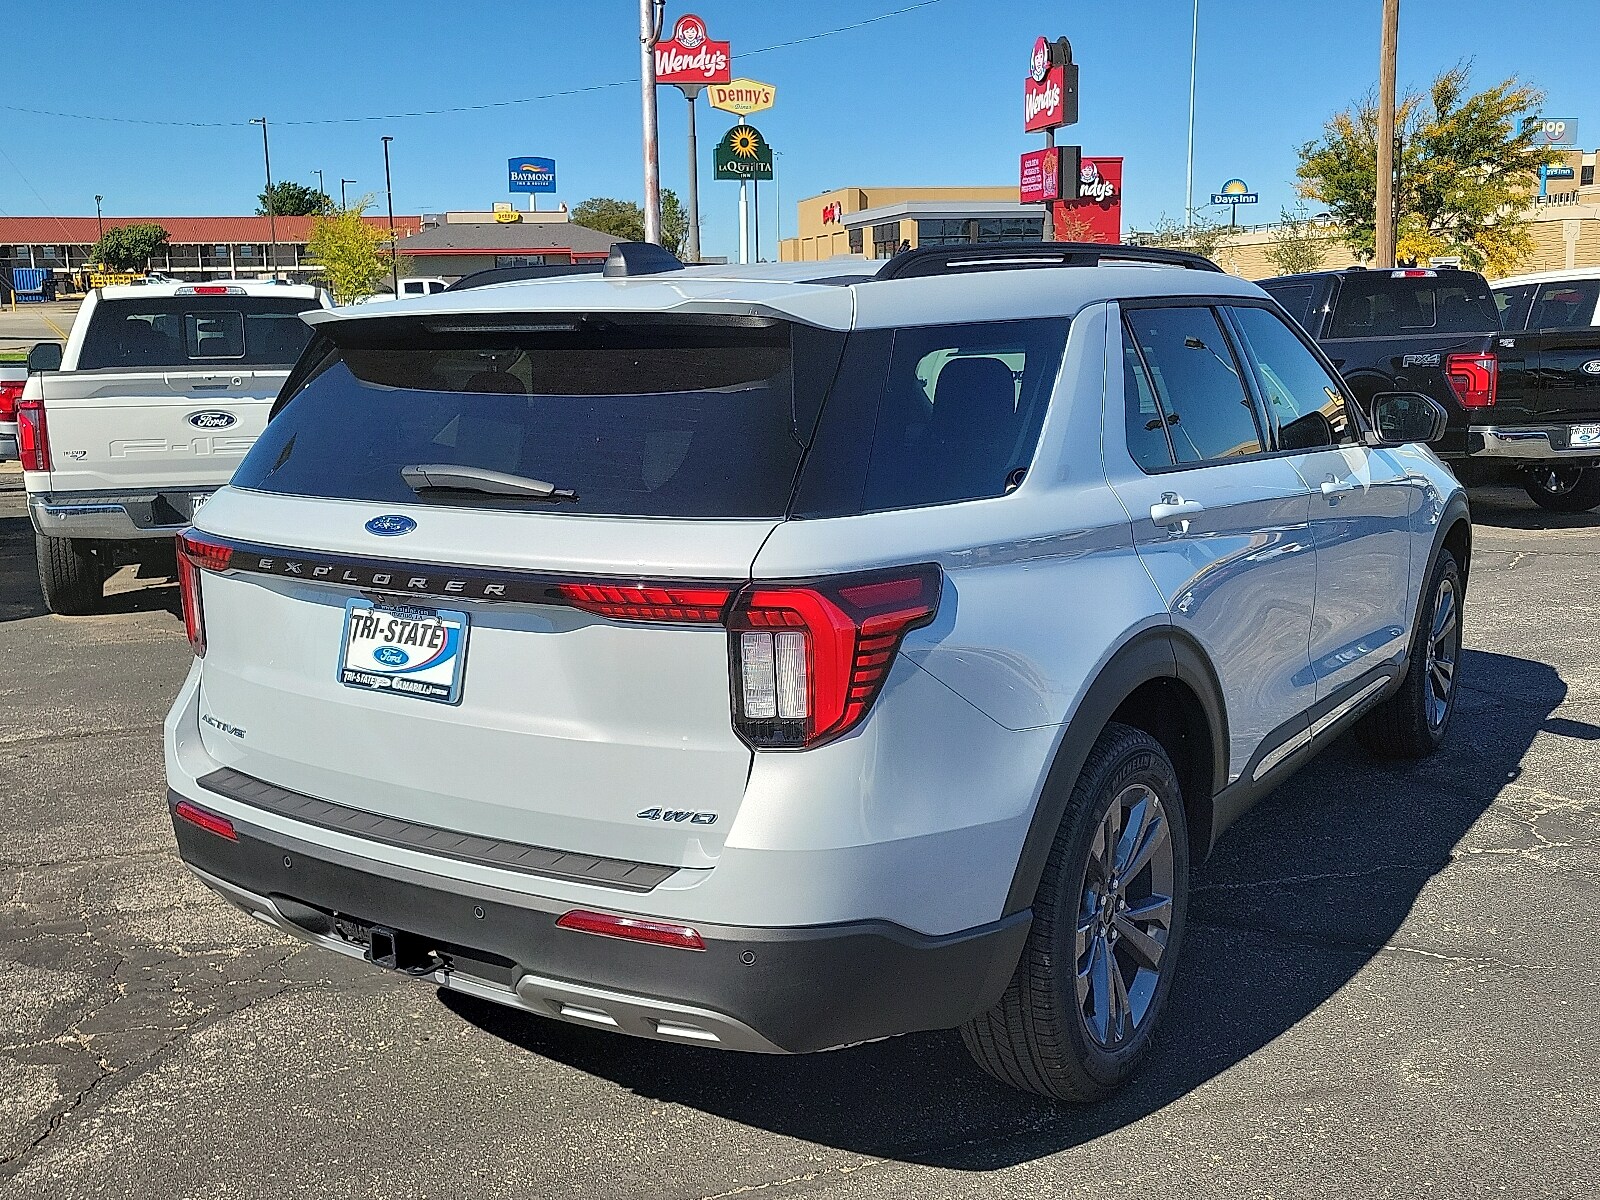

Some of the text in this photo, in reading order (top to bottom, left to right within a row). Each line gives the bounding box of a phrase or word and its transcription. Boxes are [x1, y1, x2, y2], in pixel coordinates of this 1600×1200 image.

[655, 45, 727, 77] Wendy's
[716, 88, 770, 104] Denny's
[1025, 80, 1060, 123] Wendy's
[511, 172, 554, 181] BAYMONT
[1080, 178, 1113, 201] ndy's
[1214, 195, 1239, 203] Days
[1402, 354, 1441, 368] FX4
[198, 413, 228, 427] Ford
[109, 436, 262, 458] F-15
[258, 558, 505, 596] EXPLORER
[351, 614, 445, 649] TRI-STATE
[380, 649, 403, 664] Ford
[344, 671, 375, 686] TRI-STATE
[202, 714, 246, 738] ACTIVE
[637, 807, 718, 824] 4WD
